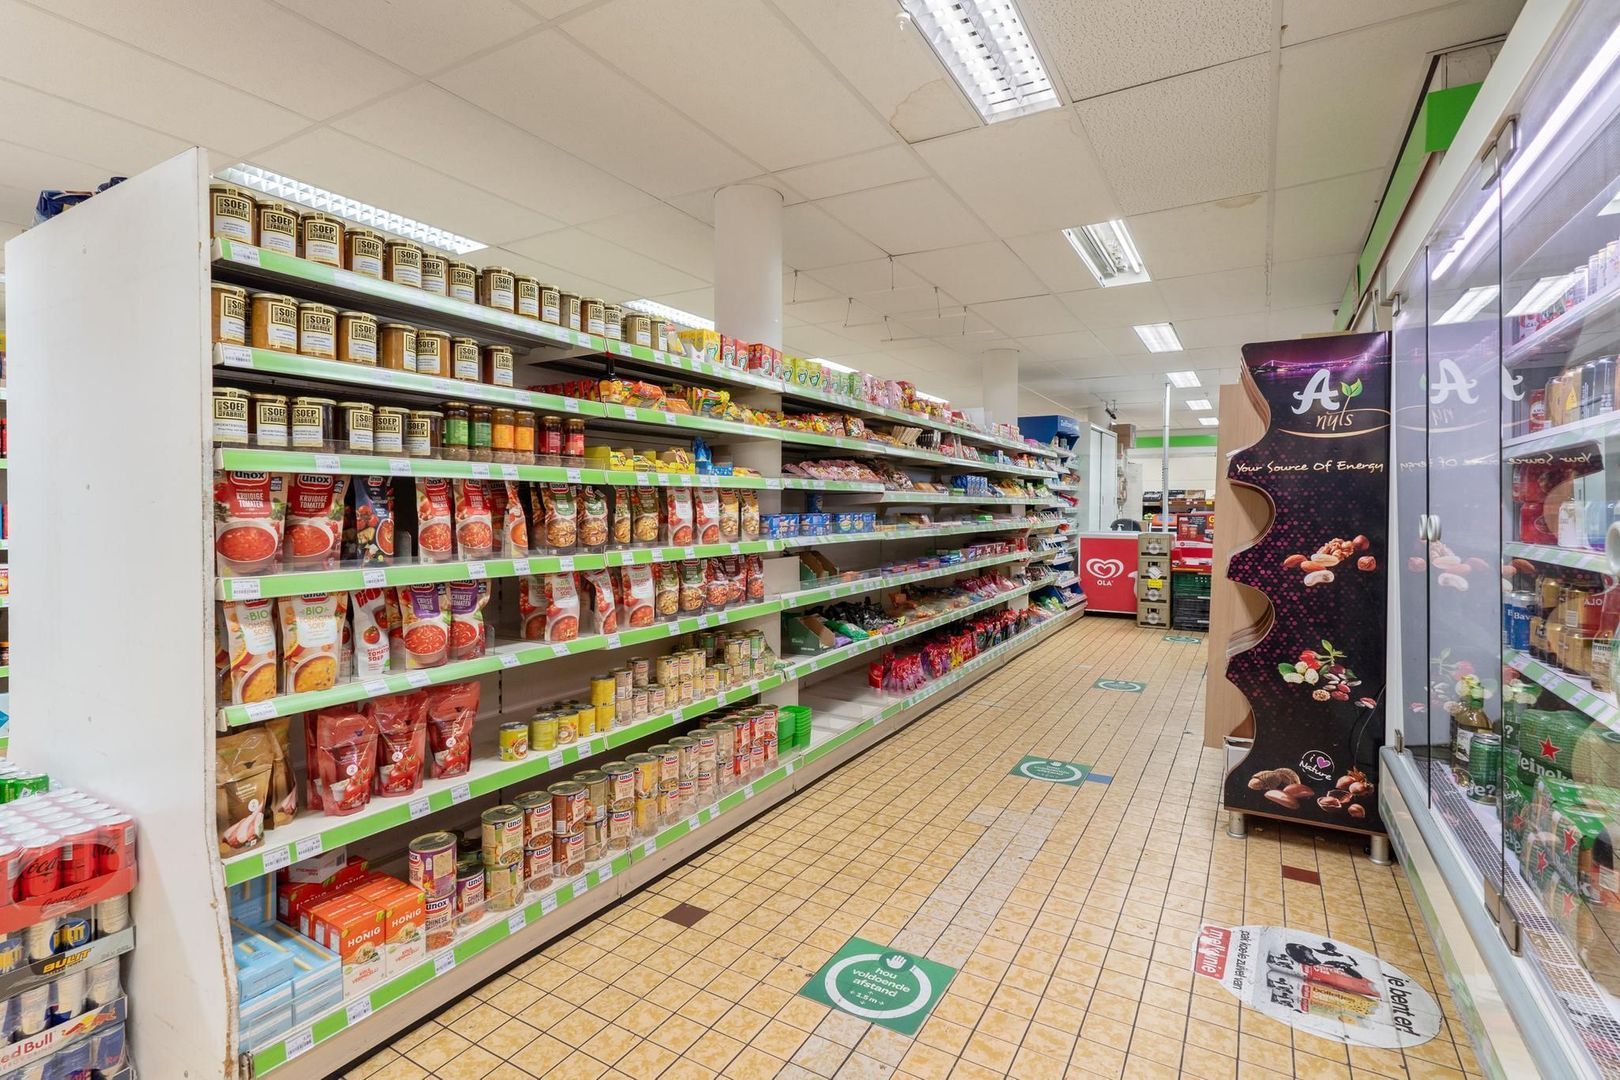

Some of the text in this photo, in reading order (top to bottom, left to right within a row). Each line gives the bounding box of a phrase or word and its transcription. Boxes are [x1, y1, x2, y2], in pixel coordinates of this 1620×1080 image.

[223, 198, 248, 211] SOEP
[270, 214, 292, 226] SOEP
[313, 224, 335, 235] SOEP
[361, 240, 380, 251] SOEP
[400, 250, 419, 260] SOEP
[422, 261, 440, 270] SOEP
[456, 271, 473, 280] SOEP
[310, 315, 331, 325] SOEP
[418, 341, 435, 349] SOEP
[222, 401, 245, 411] SOEP
[267, 406, 287, 416] SOEP
[296, 409, 317, 418] SOEP
[377, 418, 397, 427] SOEP
[408, 422, 425, 431] SOEP
[1236, 459, 1385, 474] Your Source Of Energy
[235, 471, 265, 480] unox
[302, 473, 330, 484] unox
[1096, 579, 1112, 587] OLA
[249, 609, 269, 621] BIO
[305, 605, 324, 616] BIO
[1299, 760, 1332, 781] Nature
[426, 899, 447, 910] unox
[391, 907, 422, 928] HONIG
[347, 926, 381, 948] HONIG
[1239, 930, 1252, 942] pak
[875, 967, 898, 980] hou
[1234, 959, 1248, 979] zuivel
[852, 968, 911, 993] voldoende
[1233, 977, 1244, 991] van
[852, 978, 899, 998] afstand
[1382, 973, 1421, 1037] je bent er!
[0, 1031, 53, 1064] ed Bull
